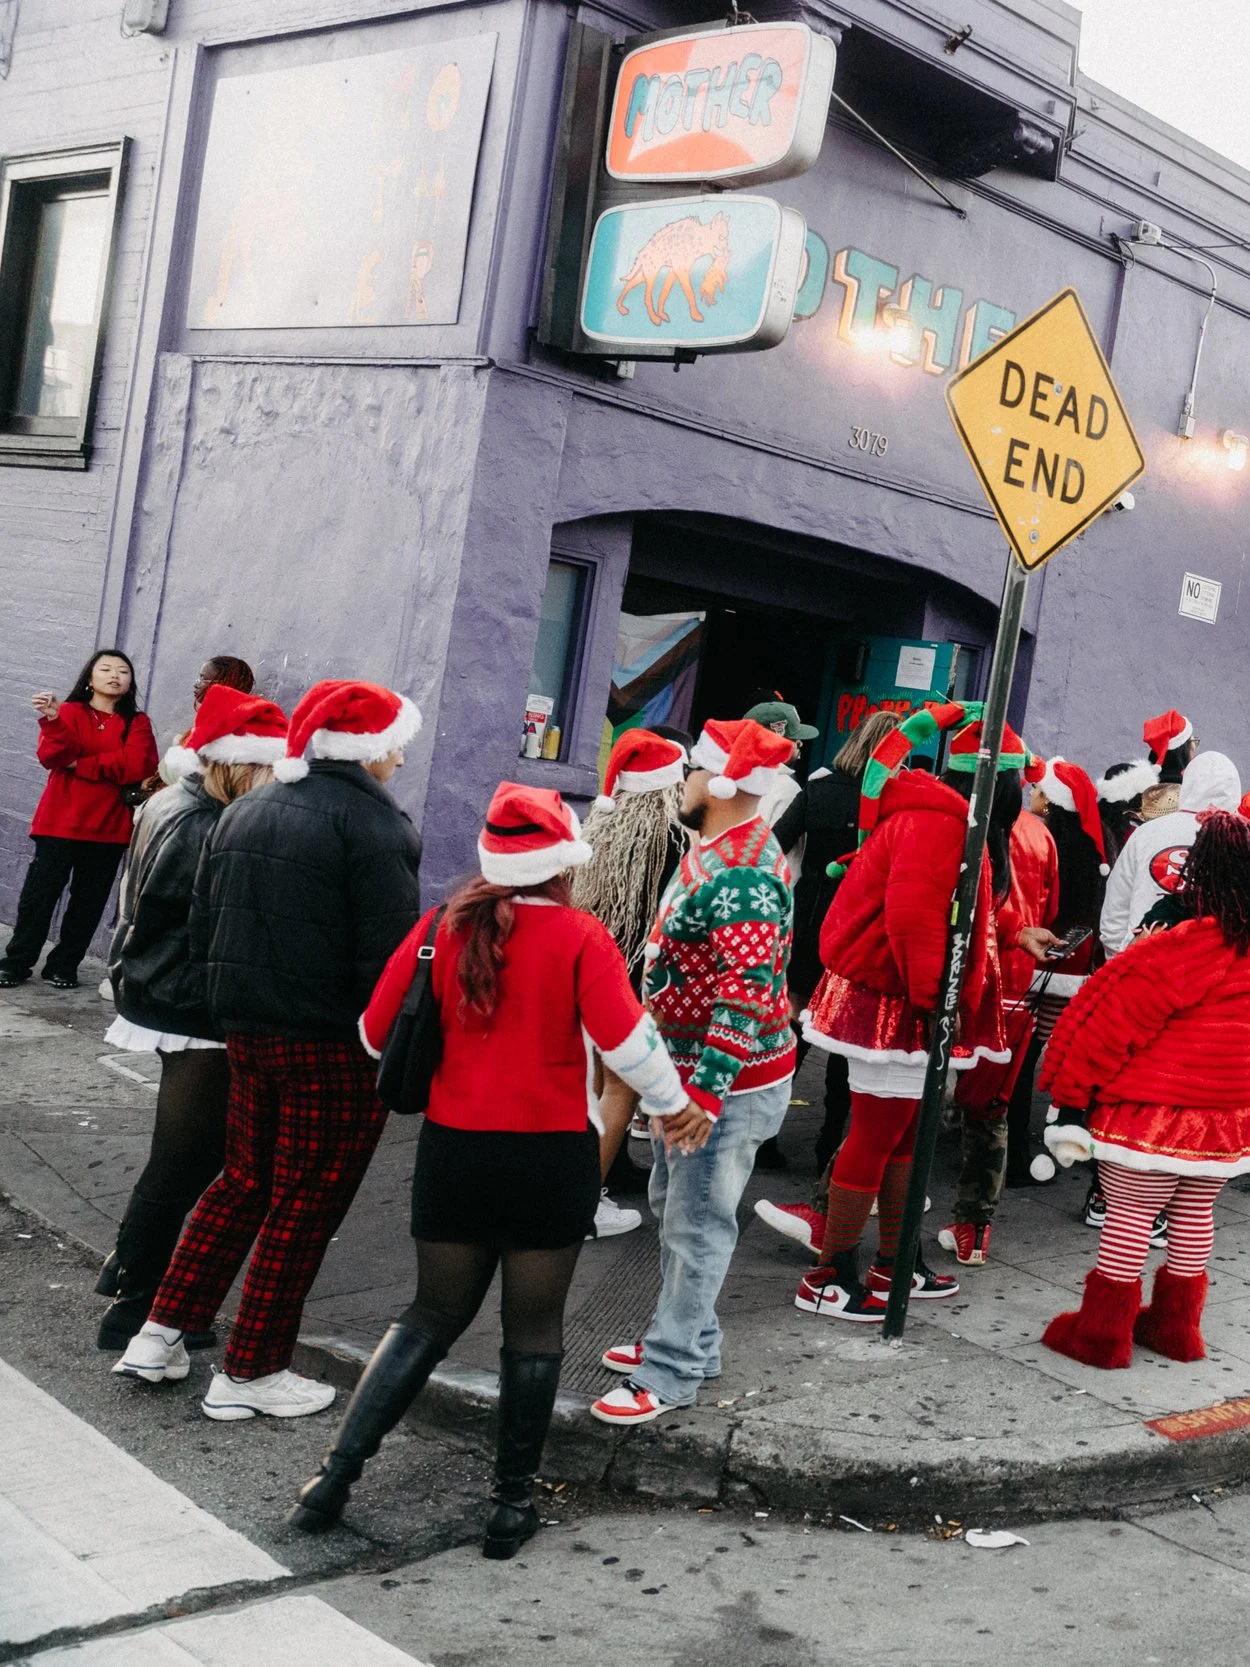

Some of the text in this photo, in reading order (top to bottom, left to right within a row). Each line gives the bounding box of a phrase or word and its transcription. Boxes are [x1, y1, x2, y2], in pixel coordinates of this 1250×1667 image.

[624, 53, 783, 141] MOTHER
[999, 360, 1109, 441] DEAD
[848, 426, 888, 457] 3079
[1004, 440, 1086, 505] END
[1186, 580, 1201, 599] NO
